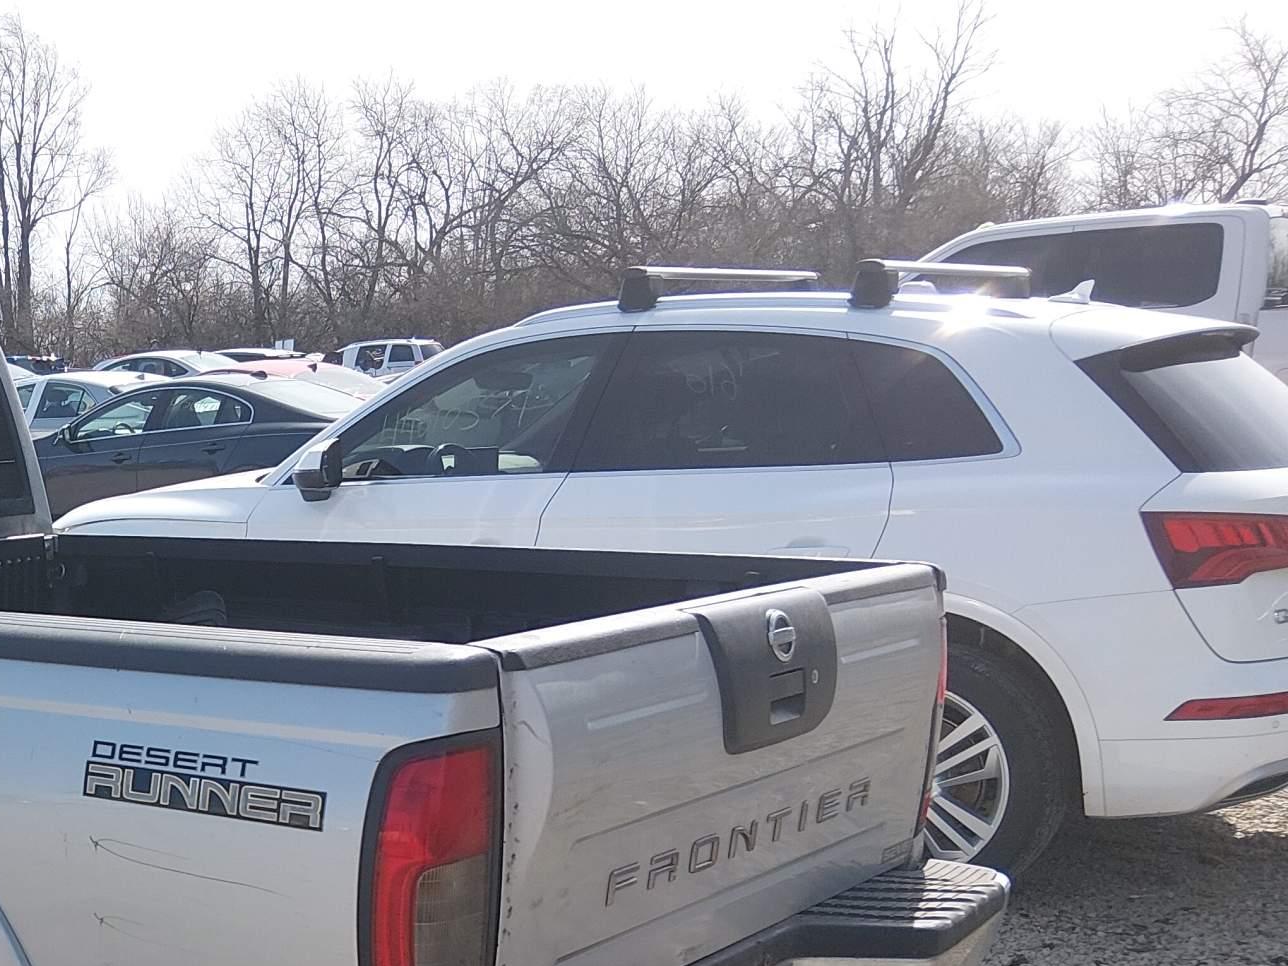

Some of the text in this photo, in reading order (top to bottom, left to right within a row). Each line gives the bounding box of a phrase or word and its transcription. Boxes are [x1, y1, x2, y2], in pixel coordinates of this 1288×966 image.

[91, 740, 259, 777] DESERT
[84, 761, 325, 830] RUNNER
[605, 776, 871, 907] FRONTIER
